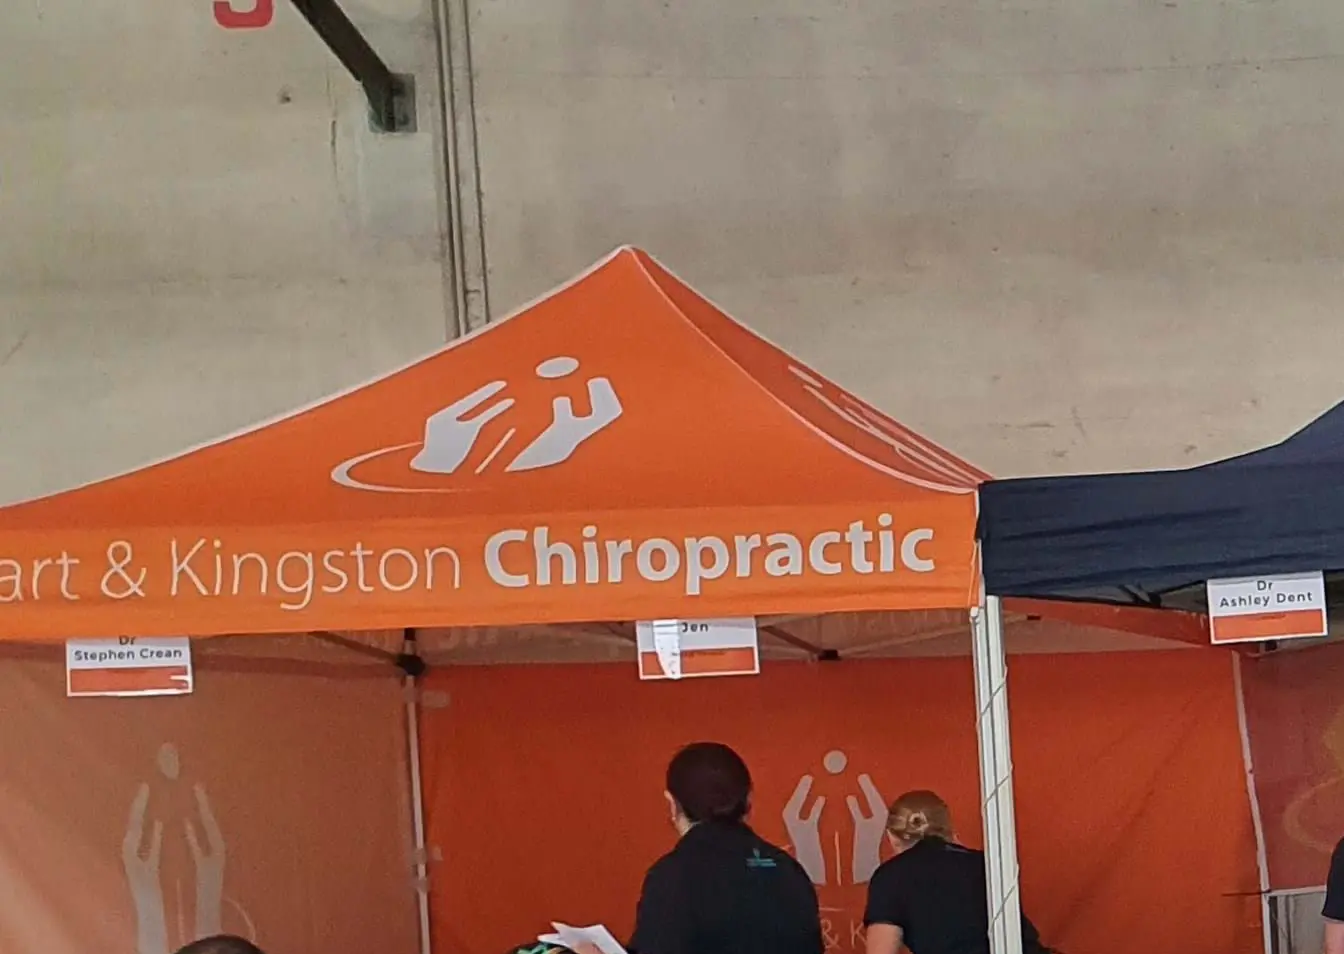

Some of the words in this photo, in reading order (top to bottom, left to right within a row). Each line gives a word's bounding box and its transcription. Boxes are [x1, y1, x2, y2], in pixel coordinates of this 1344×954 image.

[100, 540, 147, 599] &
[170, 538, 461, 610] Kingston
[484, 513, 936, 596] Chiropractic
[1256, 580, 1273, 591] Dr
[1219, 594, 1270, 608] Ashley
[1276, 591, 1313, 604] Dent
[681, 622, 709, 633] Jen
[119, 635, 137, 646] Dr
[74, 649, 135, 663] Stephen
[139, 648, 182, 659] Crean
